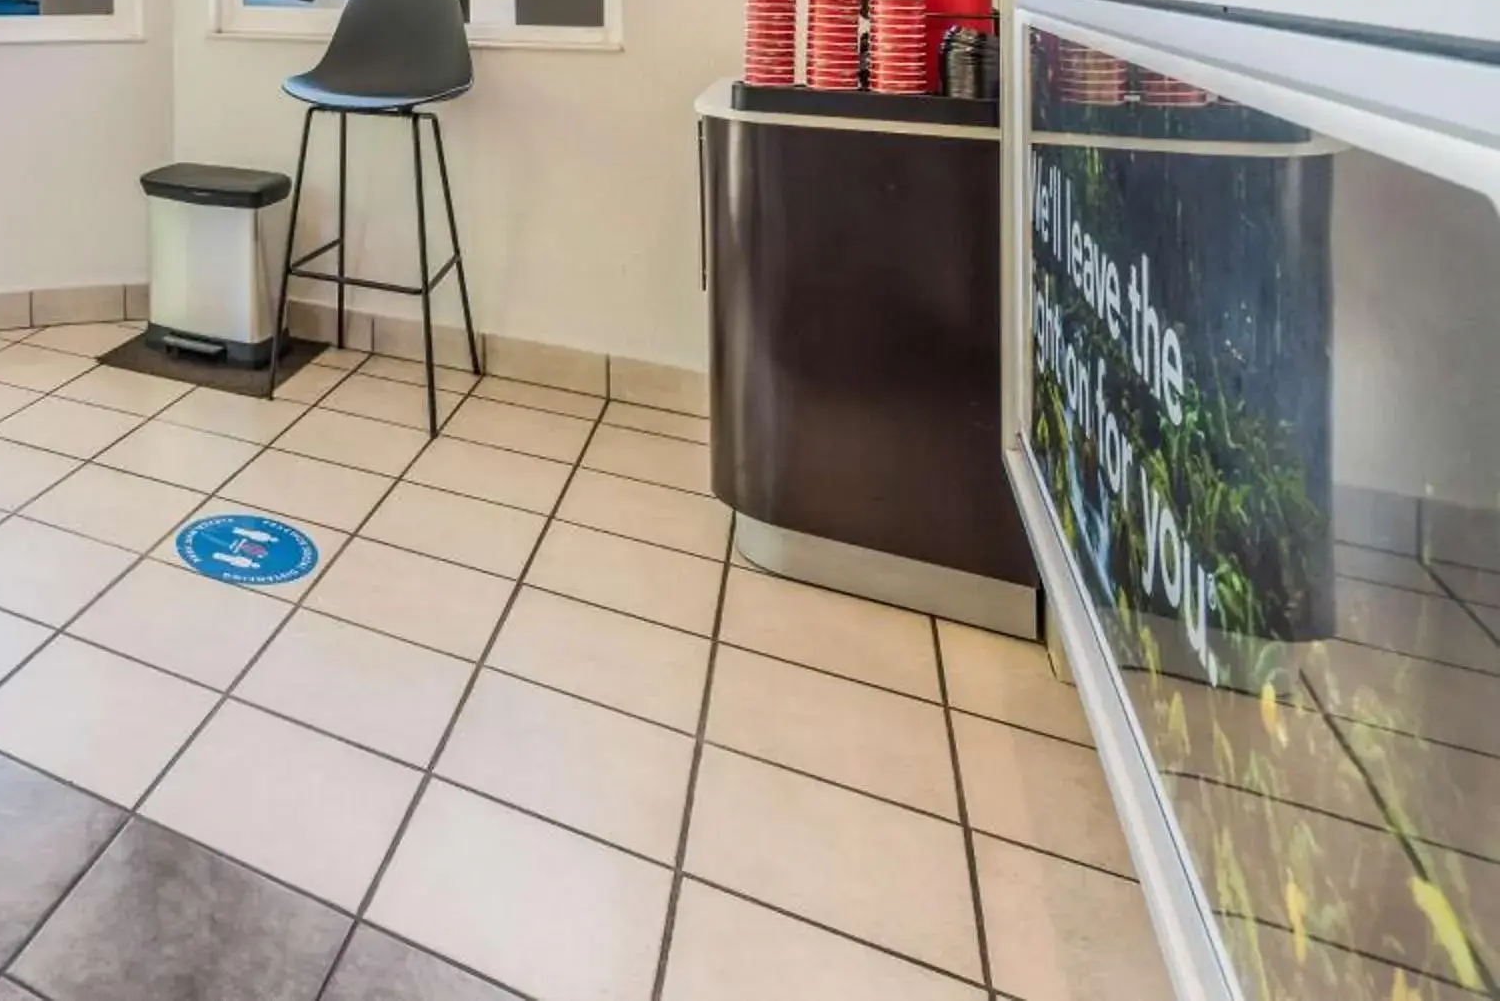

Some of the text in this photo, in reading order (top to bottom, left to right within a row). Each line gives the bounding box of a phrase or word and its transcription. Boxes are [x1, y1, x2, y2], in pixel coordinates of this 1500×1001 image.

[1066, 178, 1122, 340] leave
[1128, 252, 1185, 426] the
[1065, 342, 1091, 439] on
[1095, 356, 1132, 512] for
